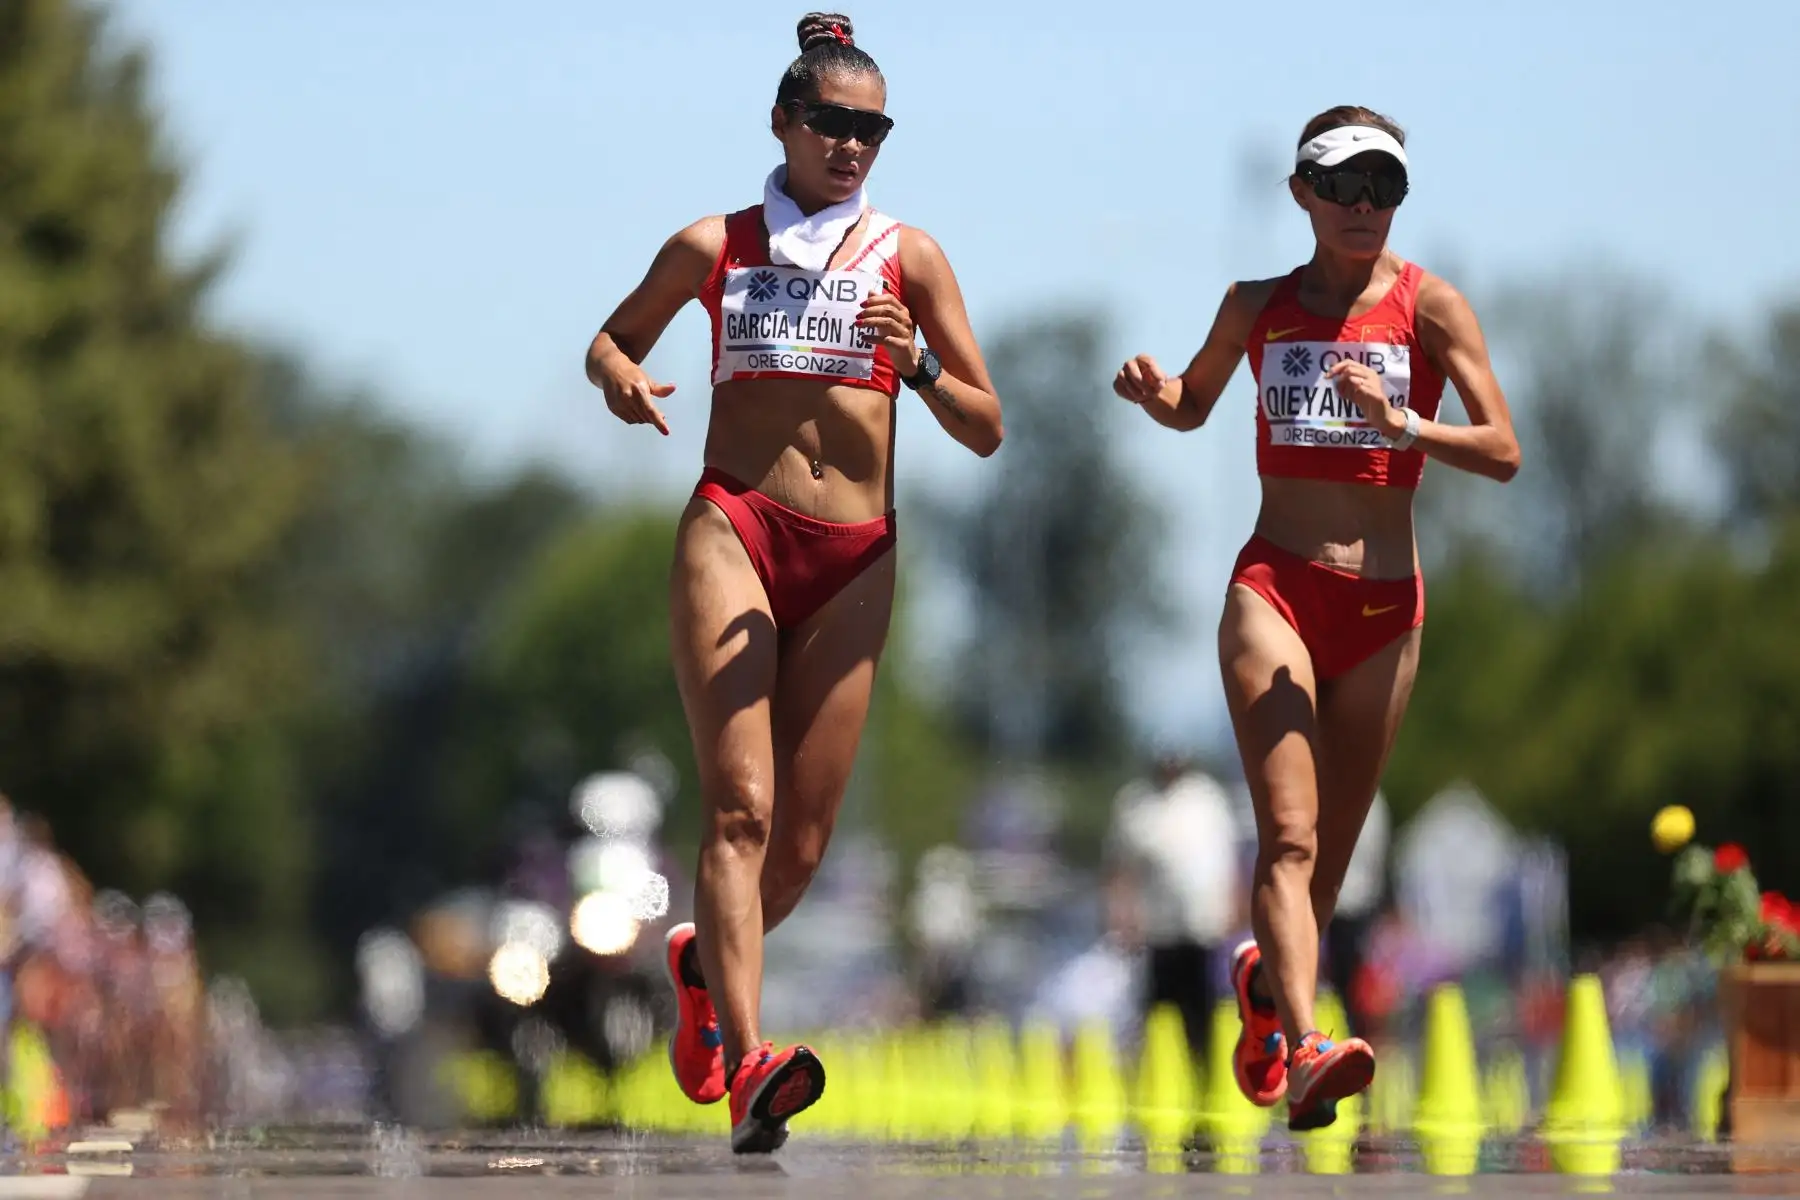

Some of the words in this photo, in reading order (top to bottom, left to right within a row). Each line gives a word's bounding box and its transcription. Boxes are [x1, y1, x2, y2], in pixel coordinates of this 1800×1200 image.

[786, 277, 858, 303] QNB
[727, 308, 789, 340] GARCÍA
[796, 311, 843, 344] LEÓN
[748, 354, 848, 375] OREGON22
[1284, 428, 1380, 445] OREGON22
